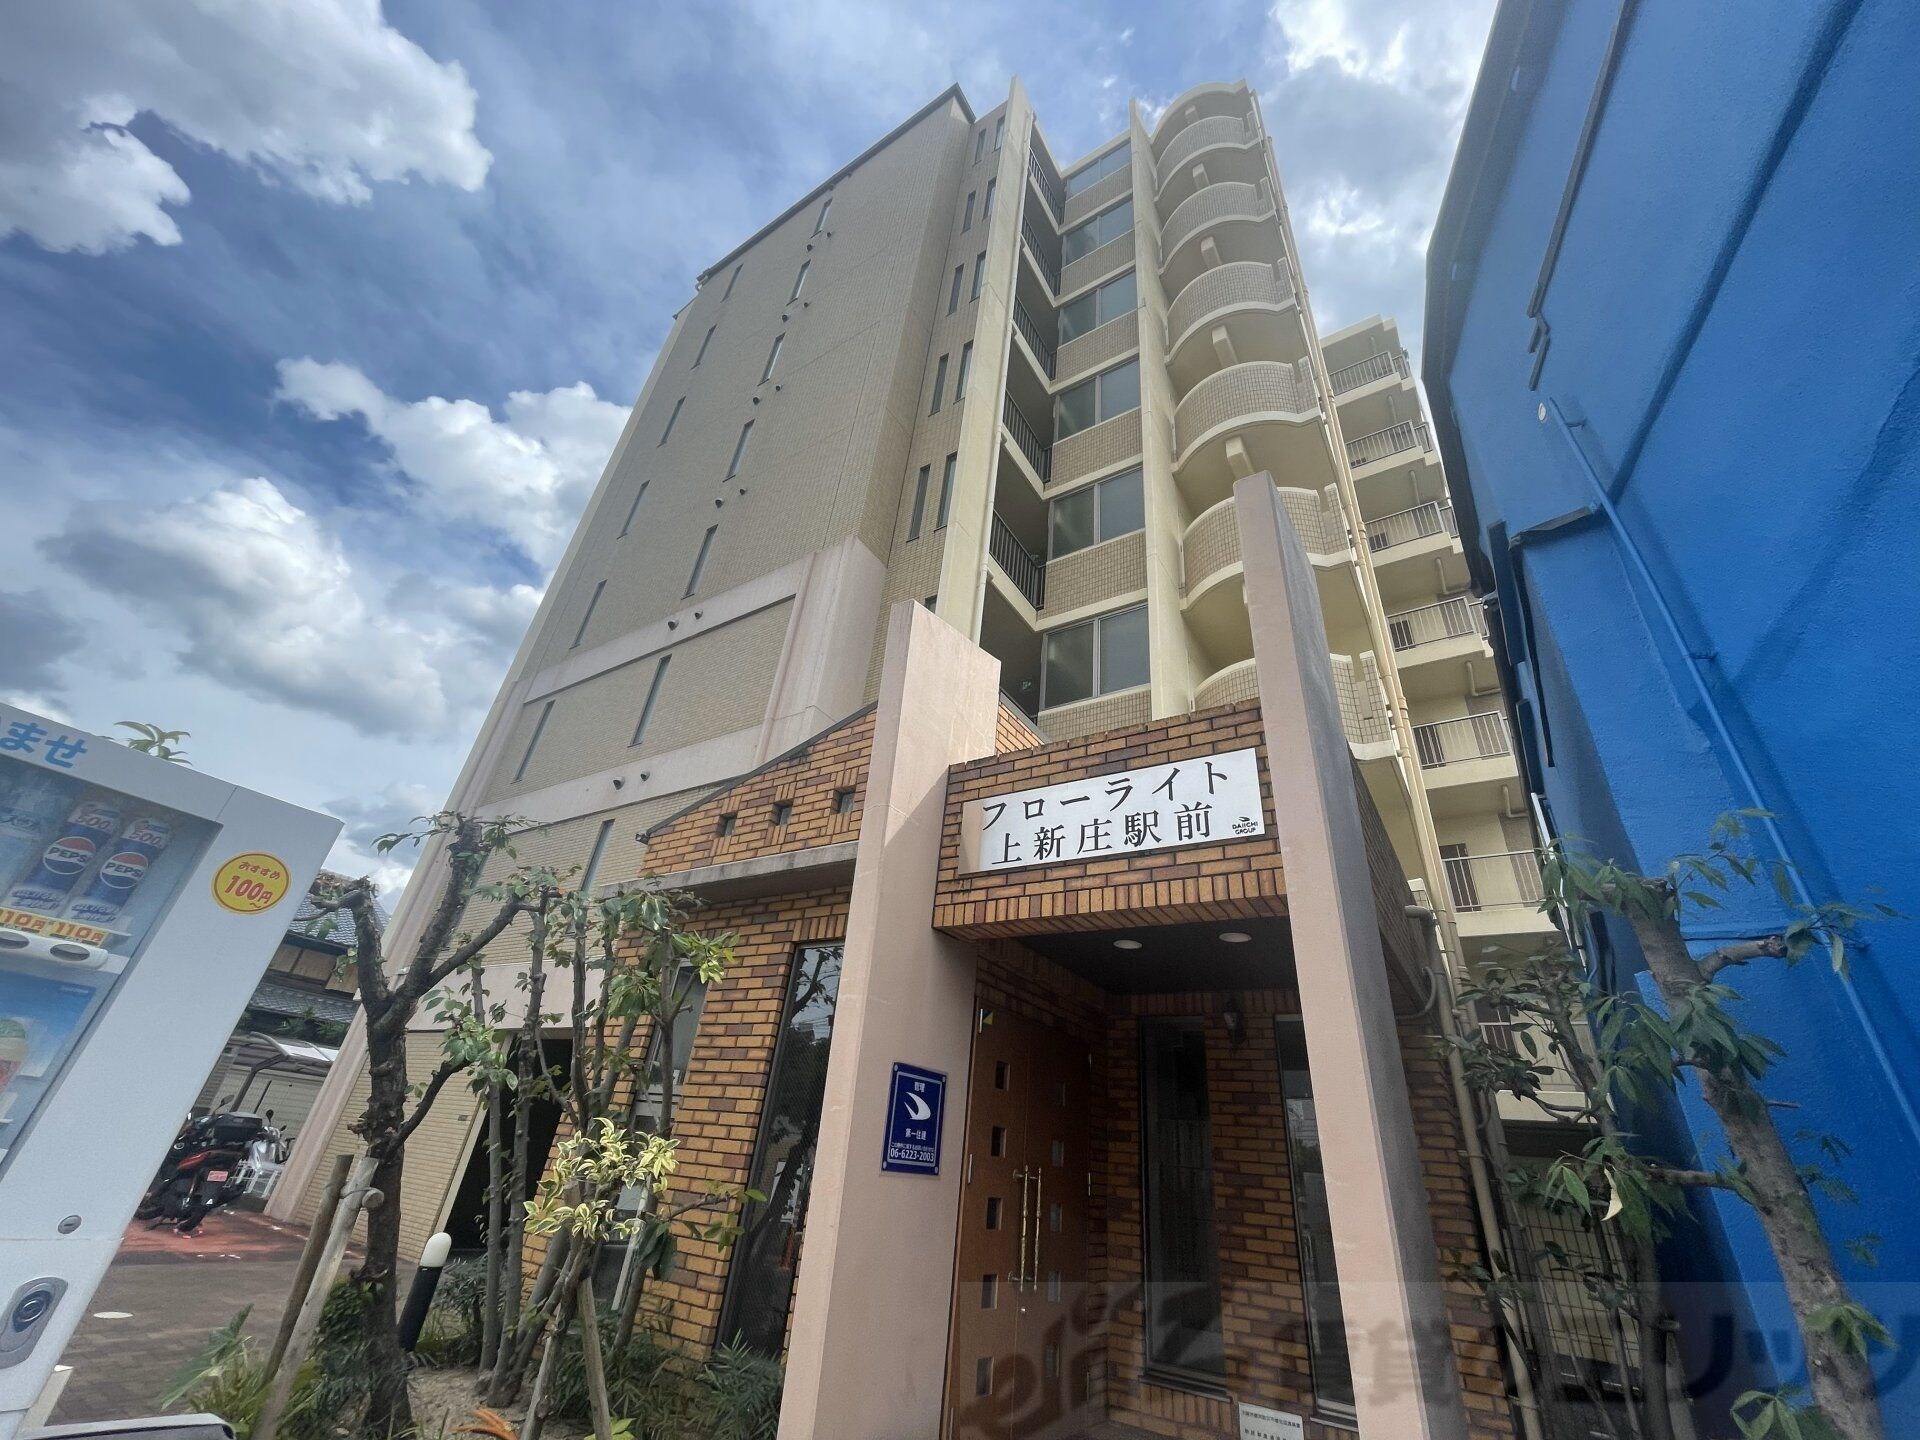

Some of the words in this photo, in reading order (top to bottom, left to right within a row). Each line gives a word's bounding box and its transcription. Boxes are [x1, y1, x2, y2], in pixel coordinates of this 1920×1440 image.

[0, 722, 88, 768] ませ
[982, 761, 1228, 831] フローライト
[991, 801, 1213, 866] 上新庄駅前
[1235, 827, 1257, 835] GROUP
[105, 862, 144, 878] PEPSI
[238, 861, 281, 880] おすすめ
[225, 875, 274, 904] 100円
[890, 1148, 935, 1162] 06-6223-2003
